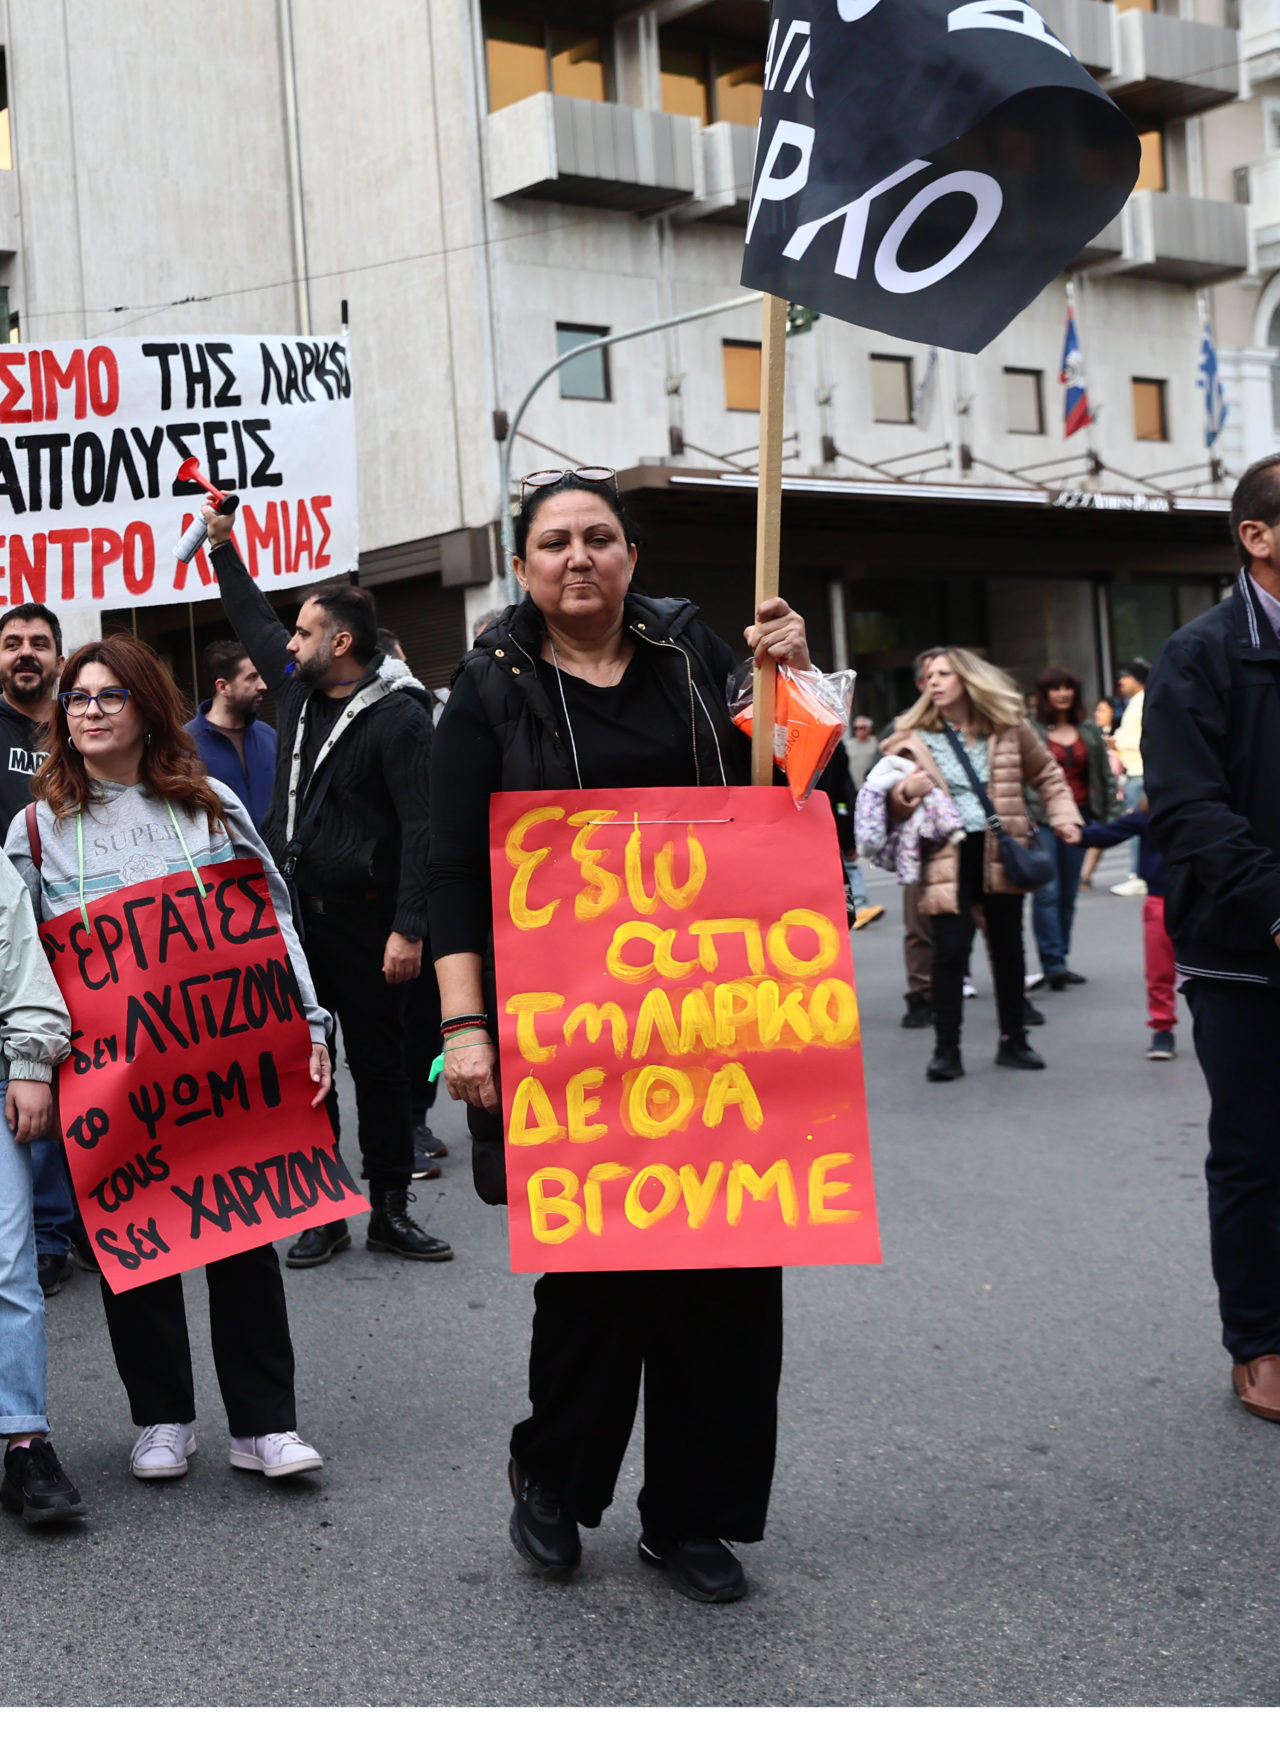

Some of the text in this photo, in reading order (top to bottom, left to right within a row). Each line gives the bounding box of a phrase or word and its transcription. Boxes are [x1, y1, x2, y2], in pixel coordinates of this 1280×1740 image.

[745, 116, 1004, 294] ΡΚΟ
[142, 343, 242, 411] ΤΗΣ
[173, 495, 332, 591] ΛΜΙΑΣ
[69, 872, 279, 991] ΕΡΓΑΤΕΣ
[631, 977, 860, 1059] ΛΑΡΚΟ
[66, 1107, 109, 1150] το
[508, 1061, 764, 1147] ΔΕ ΘΑ
[527, 1152, 863, 1245] ΒΓΟΥΜΕ
